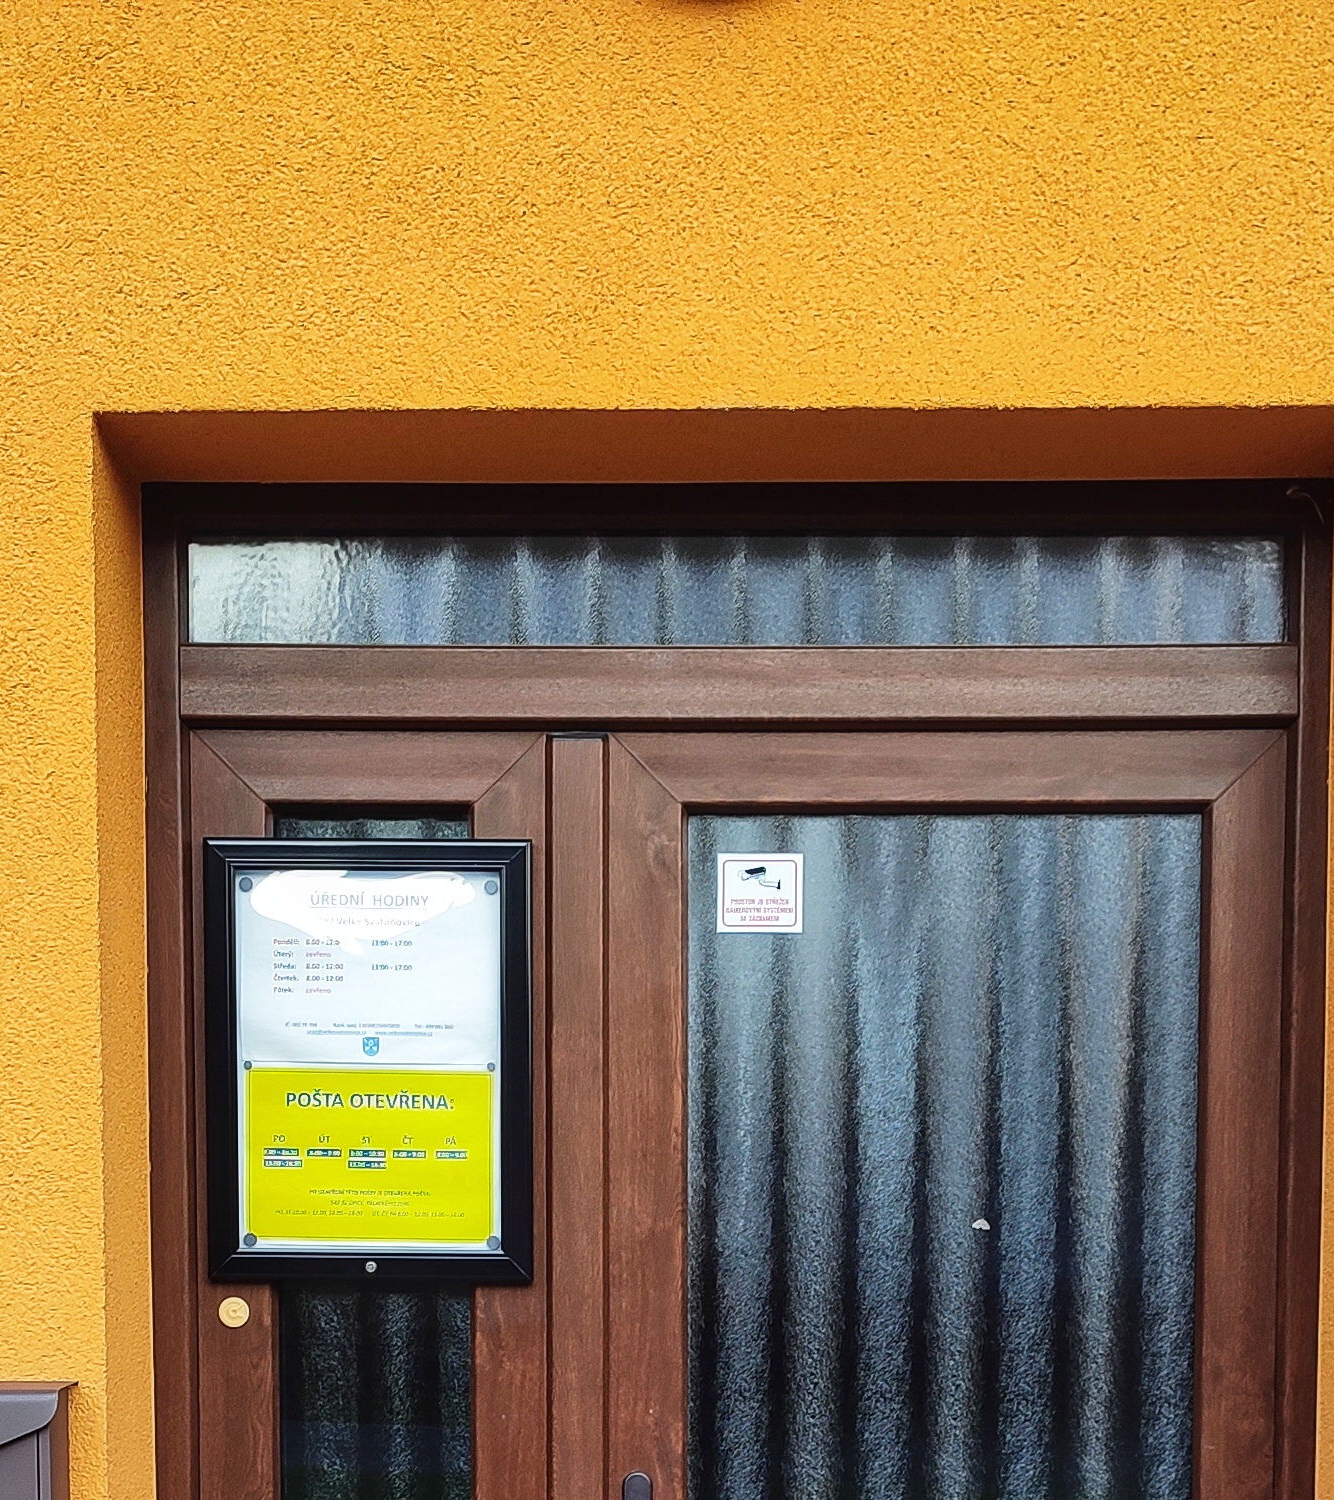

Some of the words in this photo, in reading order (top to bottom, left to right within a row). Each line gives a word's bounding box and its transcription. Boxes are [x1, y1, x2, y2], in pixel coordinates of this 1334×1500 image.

[310, 891, 364, 906] ÚŘEDNÍ
[373, 894, 429, 907] HODINY
[286, 1088, 344, 1107] POŠTA
[349, 1090, 455, 1110] OTEVŘENA:
[273, 1134, 286, 1143] PO
[318, 1133, 331, 1144] ÚT
[402, 1135, 414, 1145] ČT
[445, 1136, 457, 1145] PÁ
